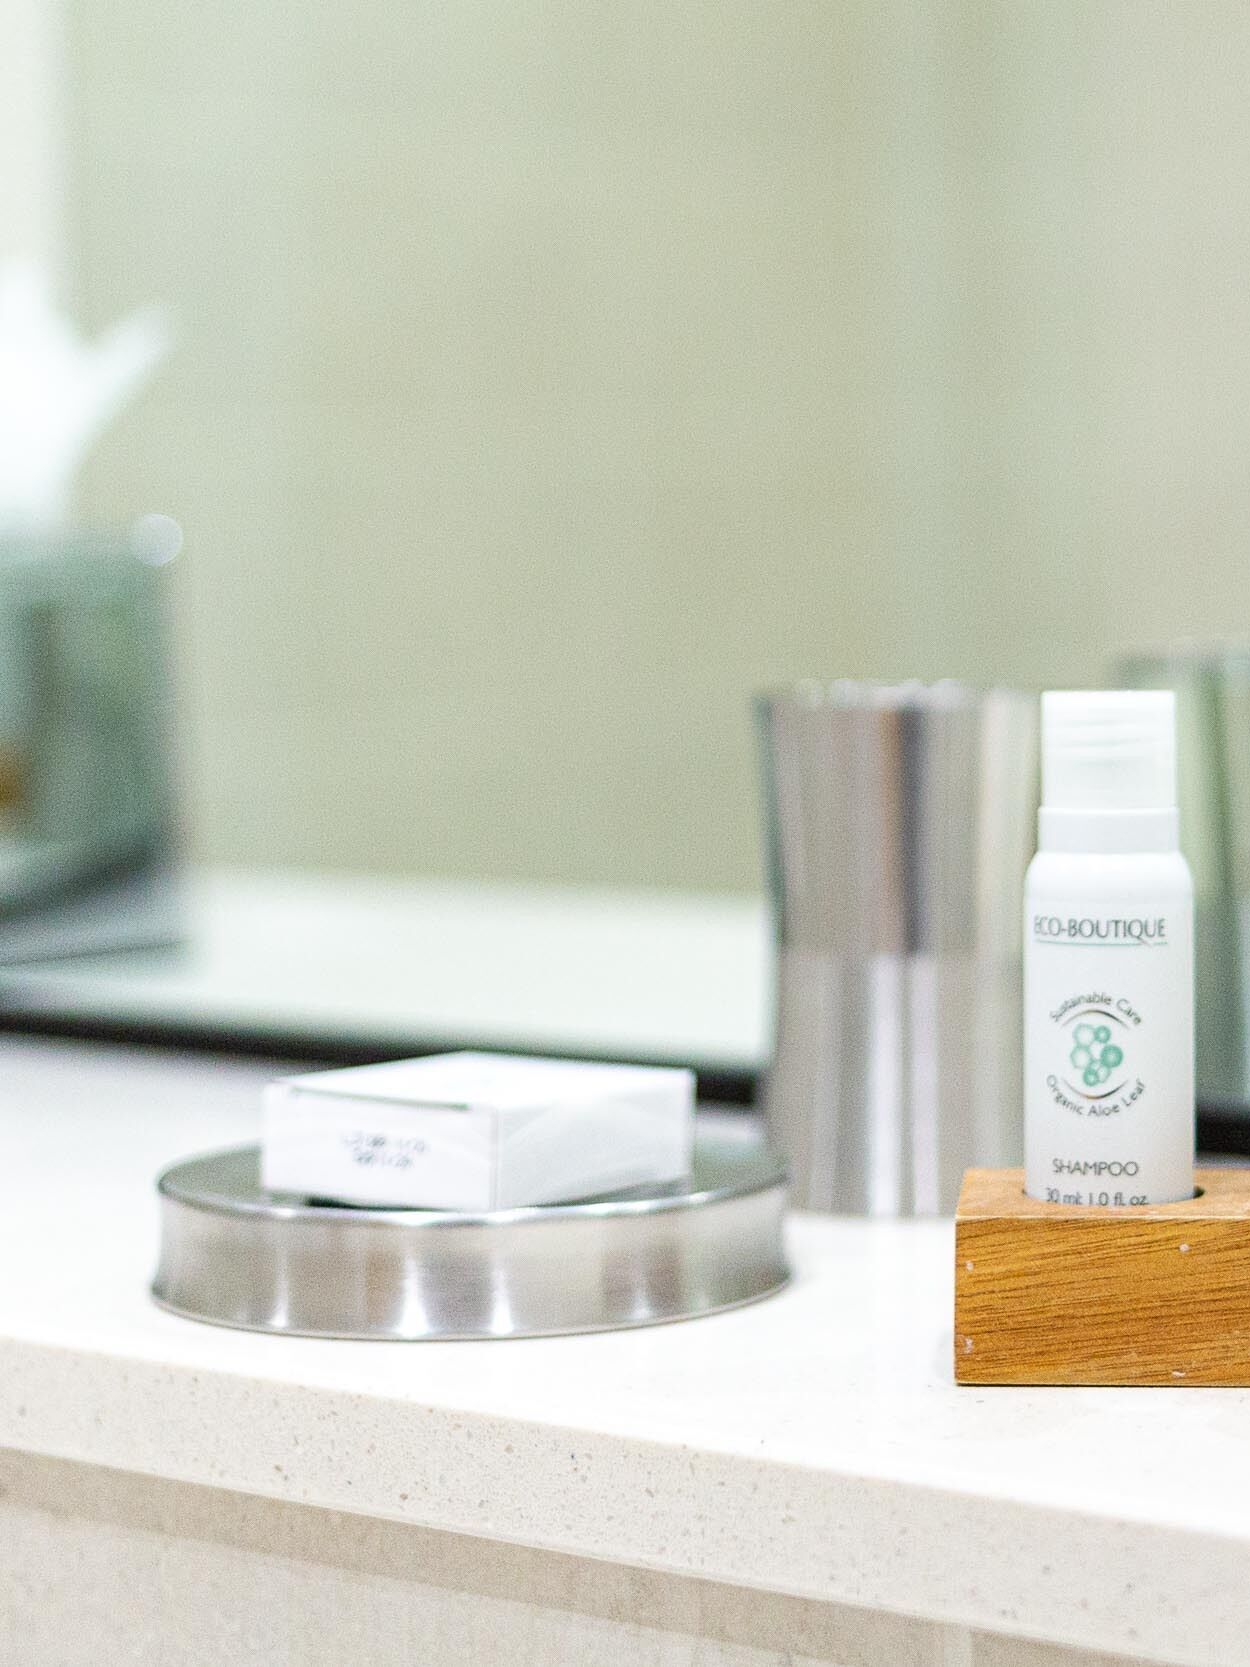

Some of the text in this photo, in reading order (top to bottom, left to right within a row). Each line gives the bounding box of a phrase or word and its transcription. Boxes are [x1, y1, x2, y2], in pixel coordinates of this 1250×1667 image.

[1034, 917, 1166, 946] ECO-BOUTIQUE
[1050, 991, 1142, 1026] Sustainable Care
[1046, 1074, 1147, 1117] Organic Aloe Leaf
[1052, 1158, 1139, 1177] SHAMPOO
